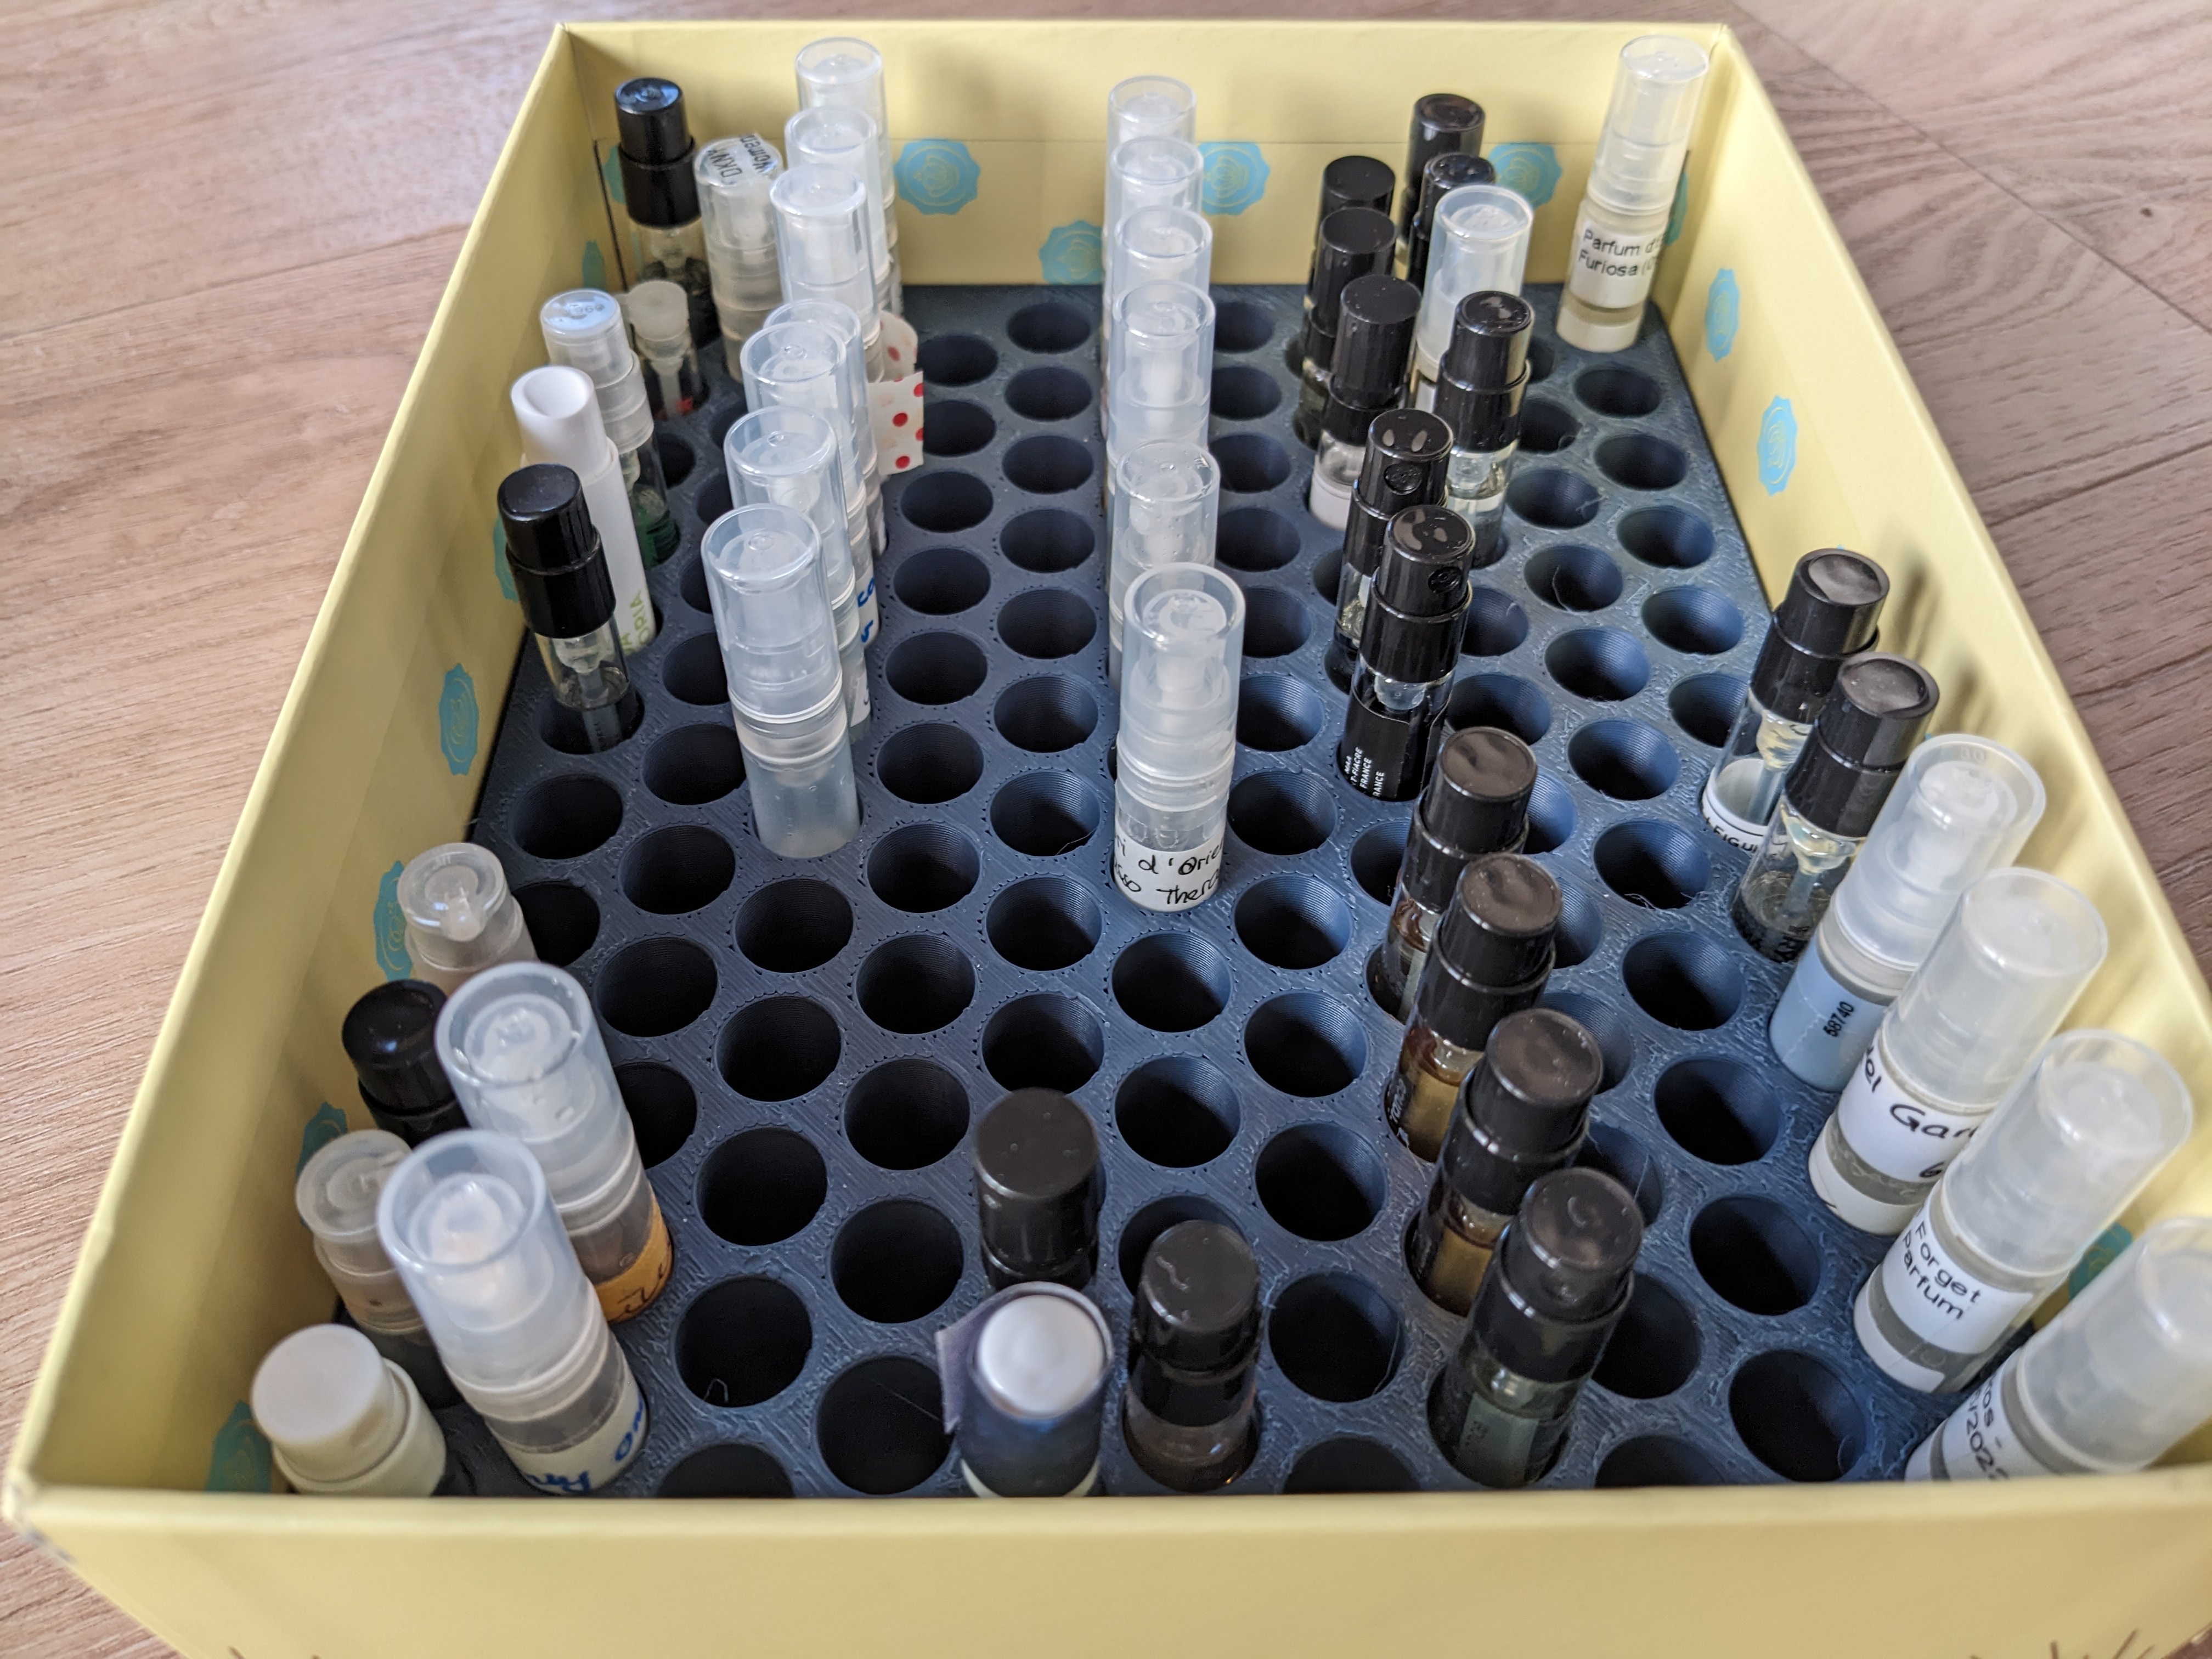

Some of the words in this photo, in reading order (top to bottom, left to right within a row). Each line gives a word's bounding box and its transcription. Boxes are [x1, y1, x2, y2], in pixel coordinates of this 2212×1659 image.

[707, 149, 743, 178] DKNY
[1583, 228, 1640, 256] Parfum
[1578, 249, 1638, 276] Furiosa
[1359, 757, 1372, 789] FRANCE
[1823, 1001, 1854, 1037] 58740
[1889, 1103, 1978, 1139] Gar
[1902, 1229, 1965, 1320] Parfum
[1915, 1220, 1981, 1304] Forget
